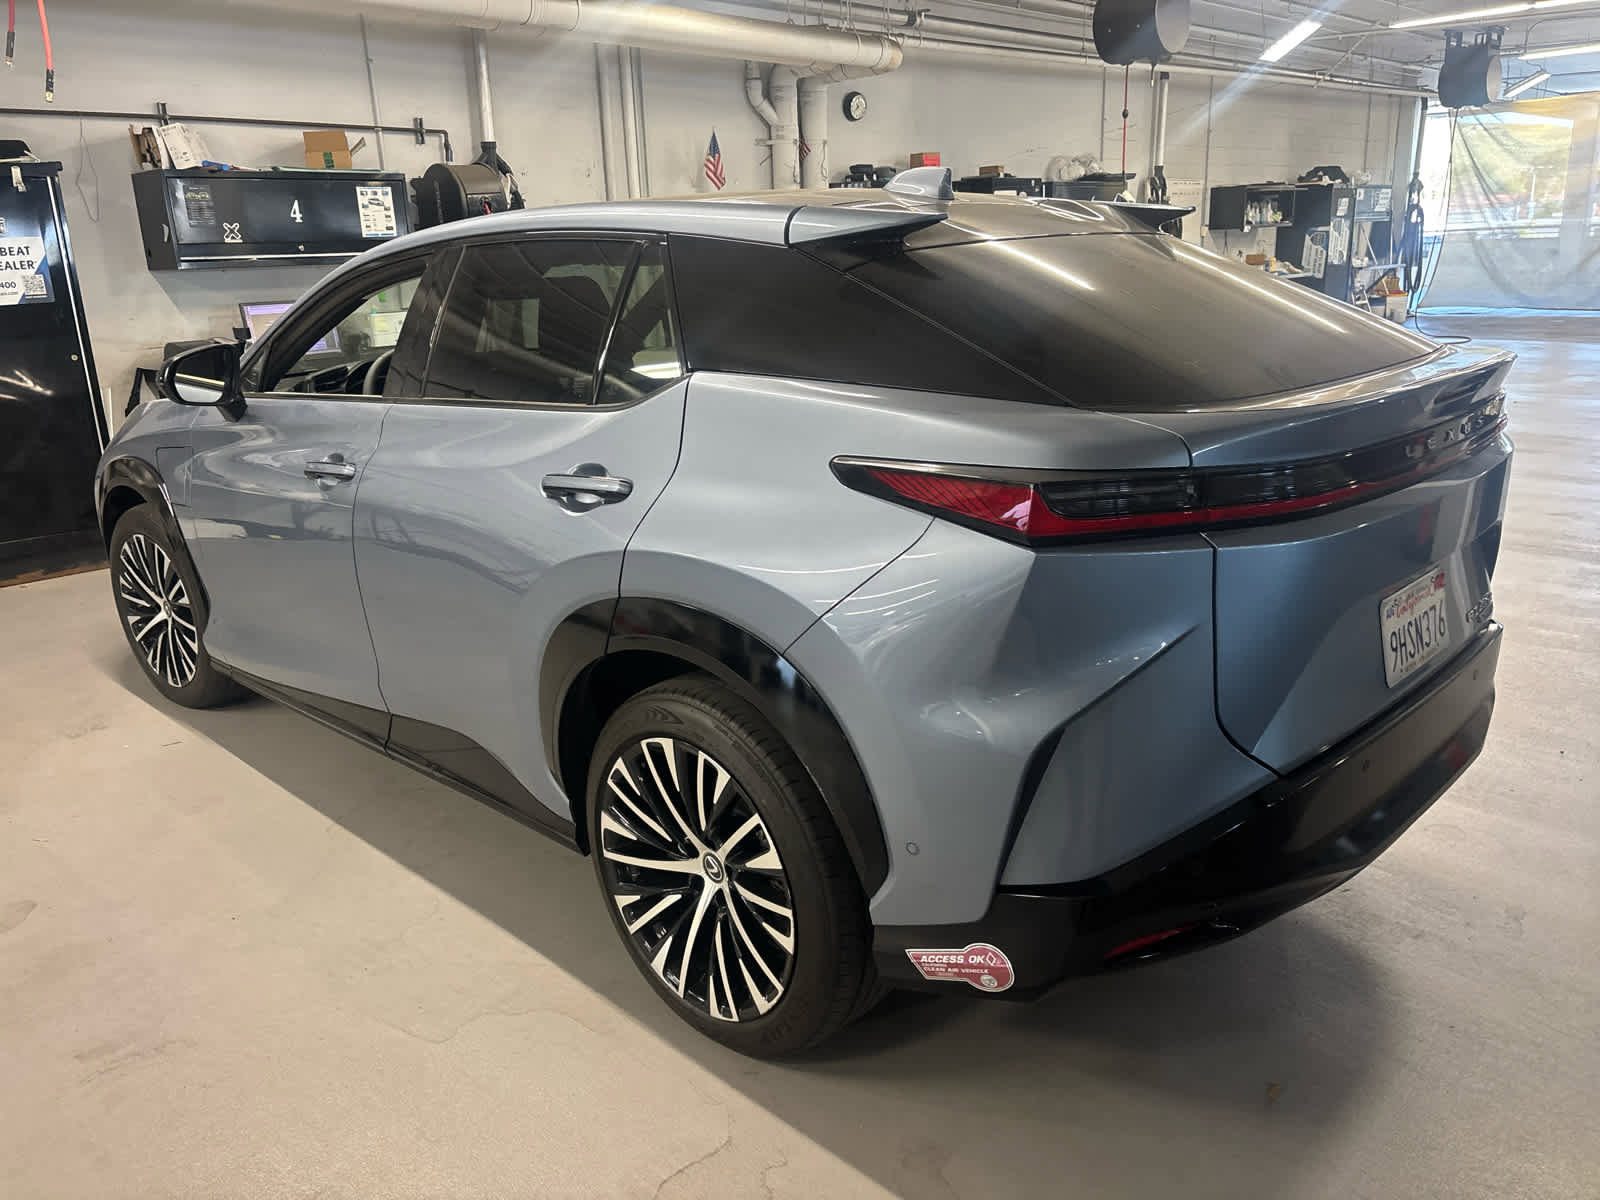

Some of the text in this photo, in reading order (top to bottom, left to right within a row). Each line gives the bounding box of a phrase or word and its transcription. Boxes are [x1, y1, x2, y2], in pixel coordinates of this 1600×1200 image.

[289, 199, 303, 223] 4
[0, 246, 30, 256] BEAT
[1390, 600, 1446, 672] 9HSN376
[920, 955, 985, 964] ACCESS OK
